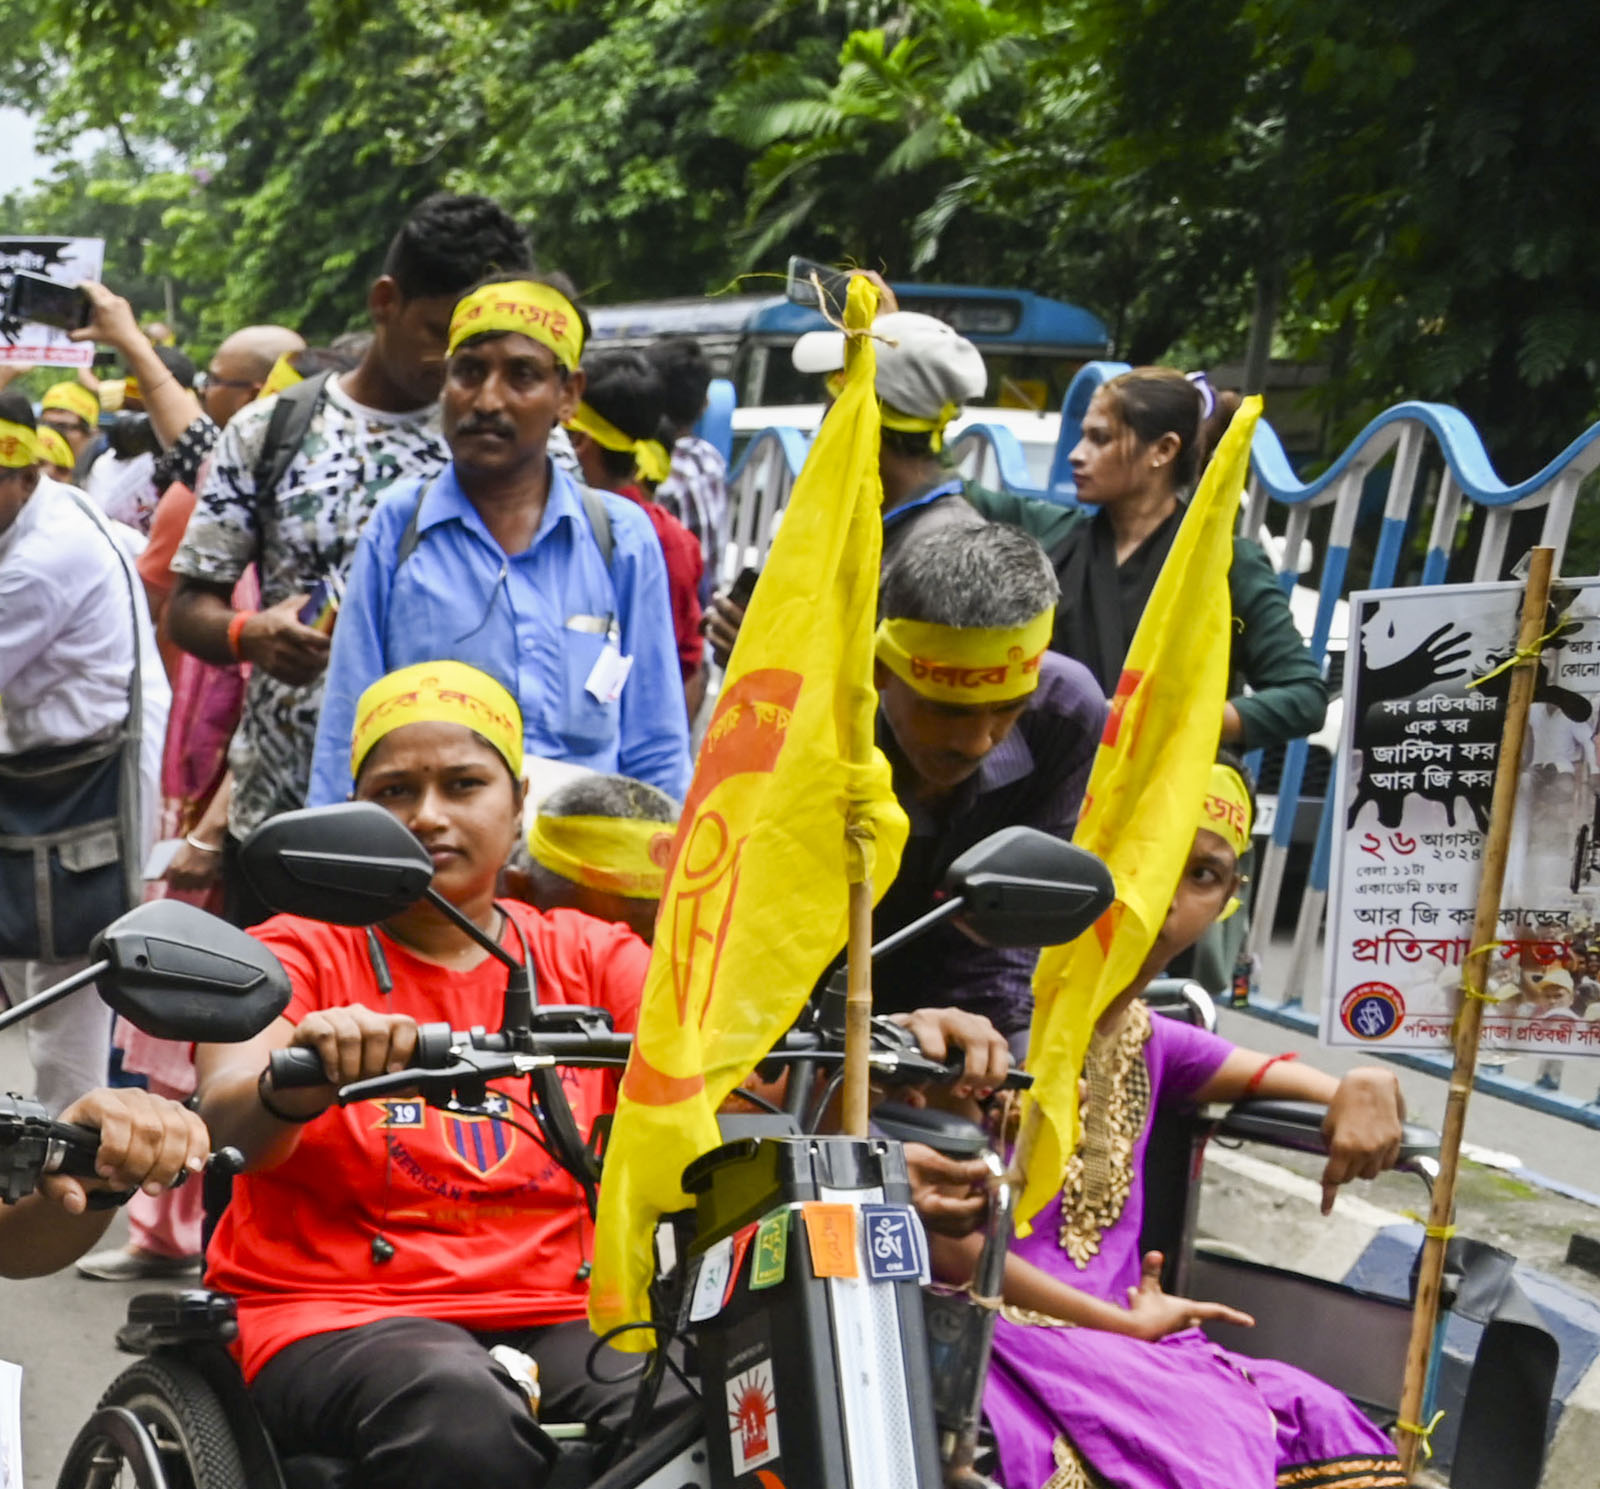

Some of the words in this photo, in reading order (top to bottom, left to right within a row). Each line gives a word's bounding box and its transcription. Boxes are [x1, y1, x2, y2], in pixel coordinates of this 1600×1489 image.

[910, 655, 1010, 689] চলবে
[1382, 699, 1412, 716] সব
[1416, 691, 1499, 715] প্রতিবন্ধীর
[1404, 718, 1438, 736] এক
[1440, 717, 1471, 735] স্বর
[1371, 738, 1454, 765] জাস্টিস
[1457, 742, 1497, 761] ফর
[1369, 770, 1418, 791] আর
[1421, 764, 1454, 791] জি
[1457, 769, 1495, 789] কর
[1359, 831, 1418, 862] ২৬
[1419, 829, 1482, 850] আগস্ট
[1431, 849, 1482, 862] ২০২৪
[1355, 864, 1387, 878] বেলা
[1354, 878, 1422, 896] একাডেমি
[1353, 906, 1403, 927] আর
[1410, 901, 1441, 927] জি
[1352, 928, 1472, 968] প্রতিবা
[1515, 1021, 1573, 1045] প্রতিবন্ধী
[393, 1104, 417, 1123] 19
[382, 1133, 464, 1200] AMERICAN
